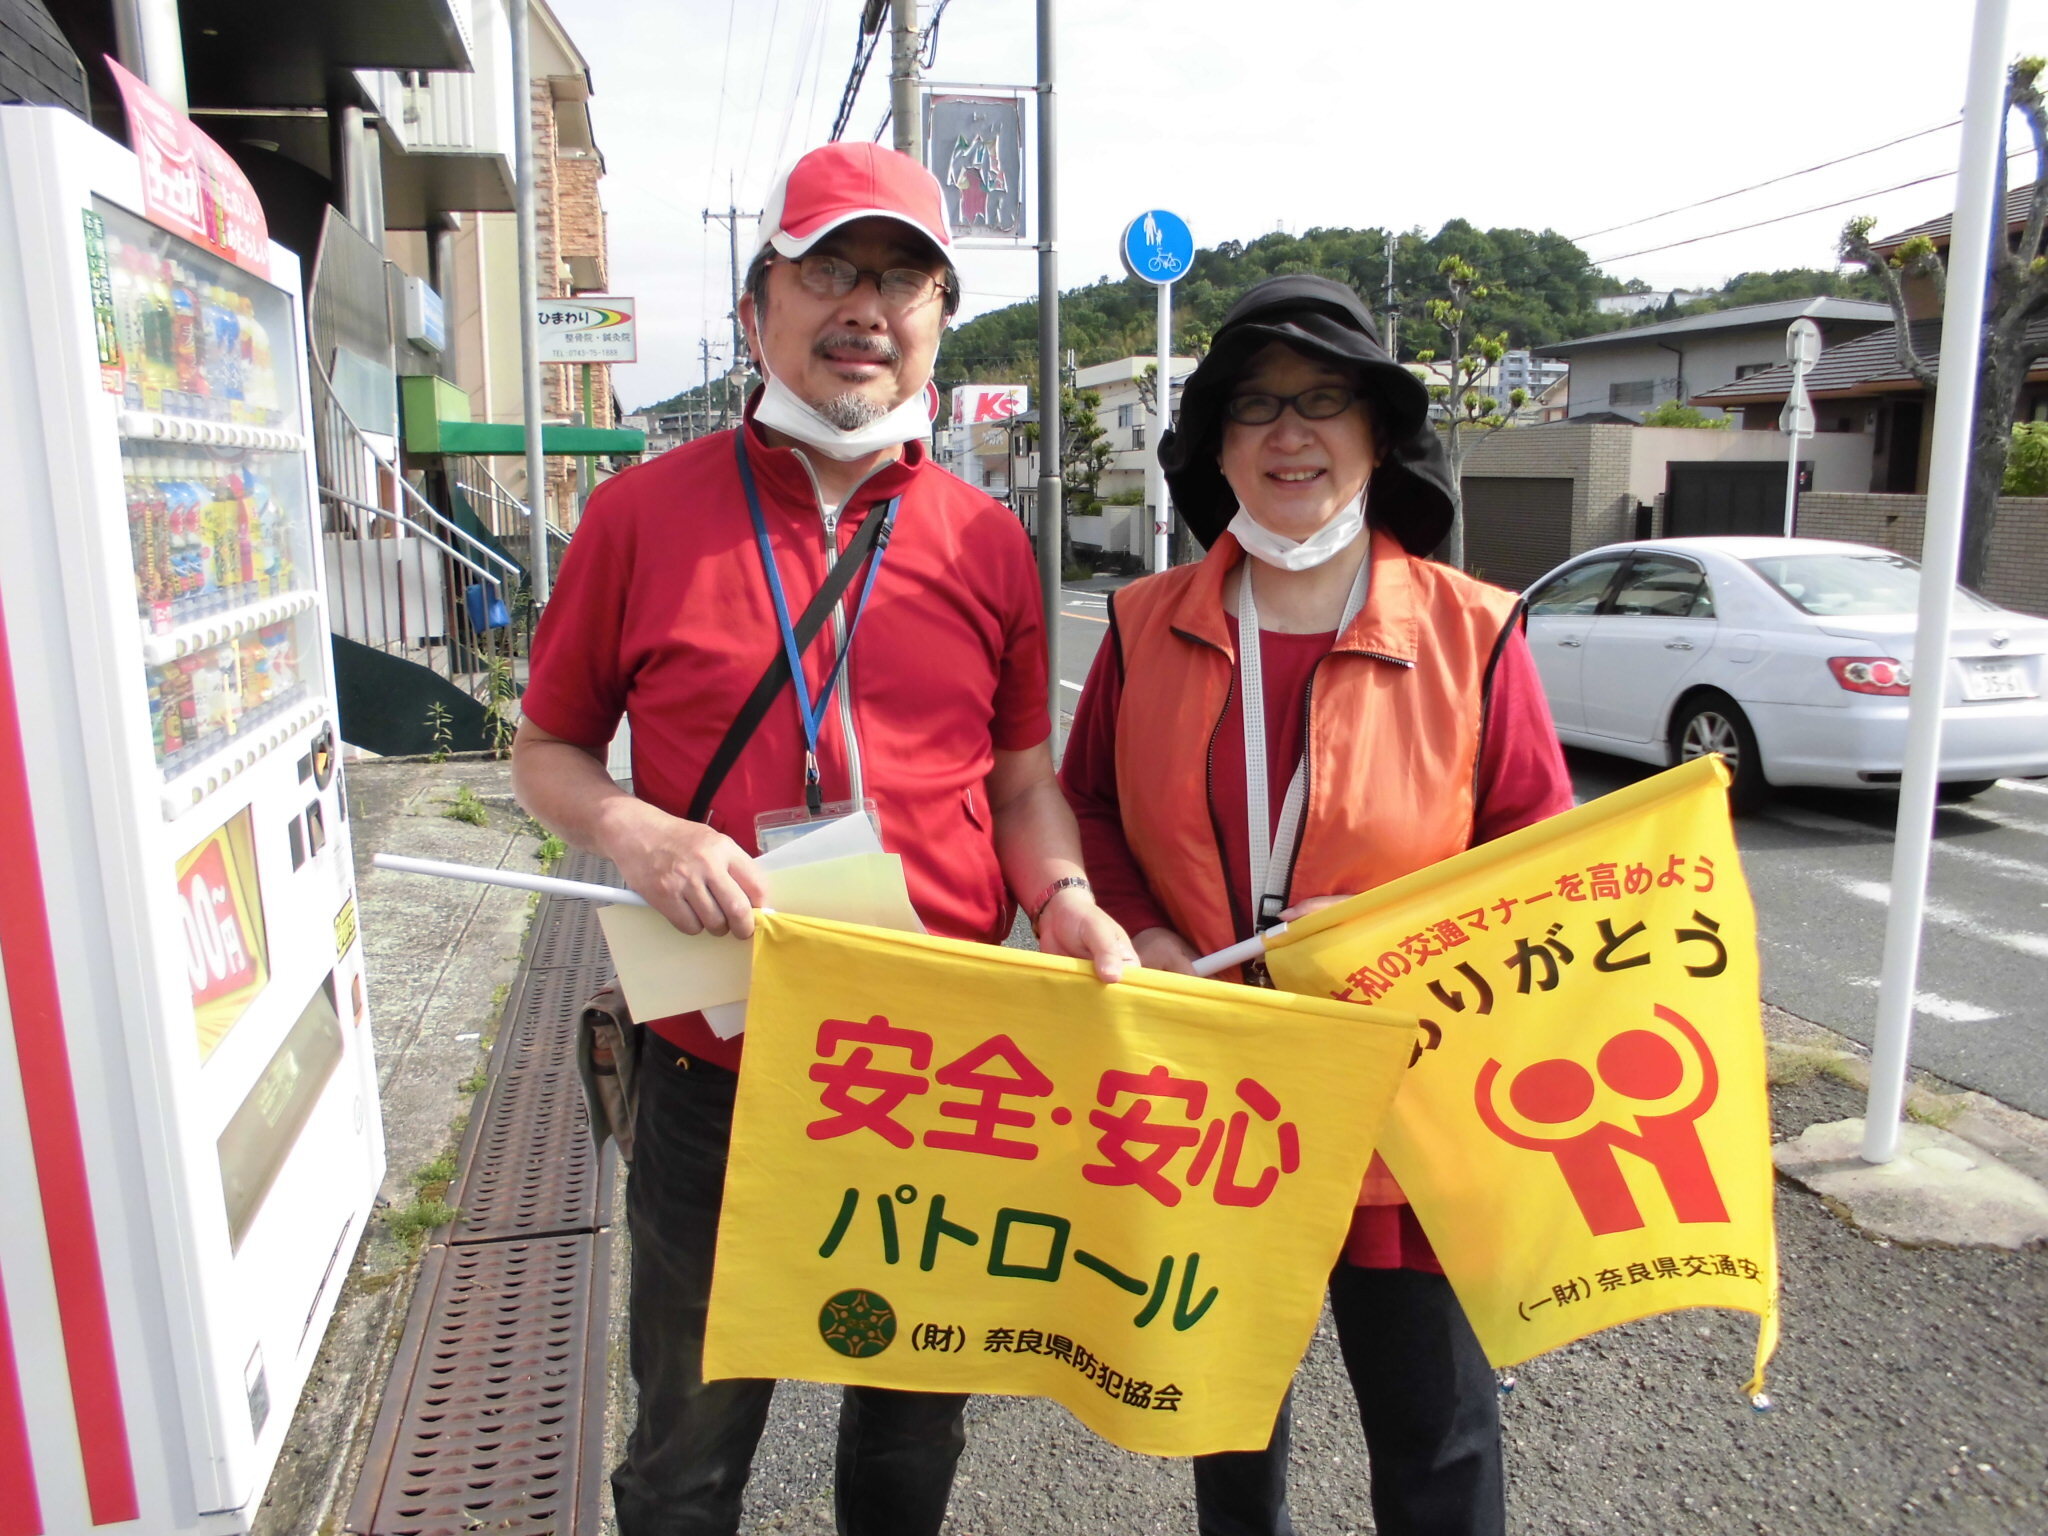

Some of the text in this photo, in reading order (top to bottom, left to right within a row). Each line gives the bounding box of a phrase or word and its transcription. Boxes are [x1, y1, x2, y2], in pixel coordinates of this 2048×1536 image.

[538, 311, 589, 325] ひまわり
[805, 1015, 1301, 1208] 安全・安心
[818, 1184, 1219, 1332] パトロール
